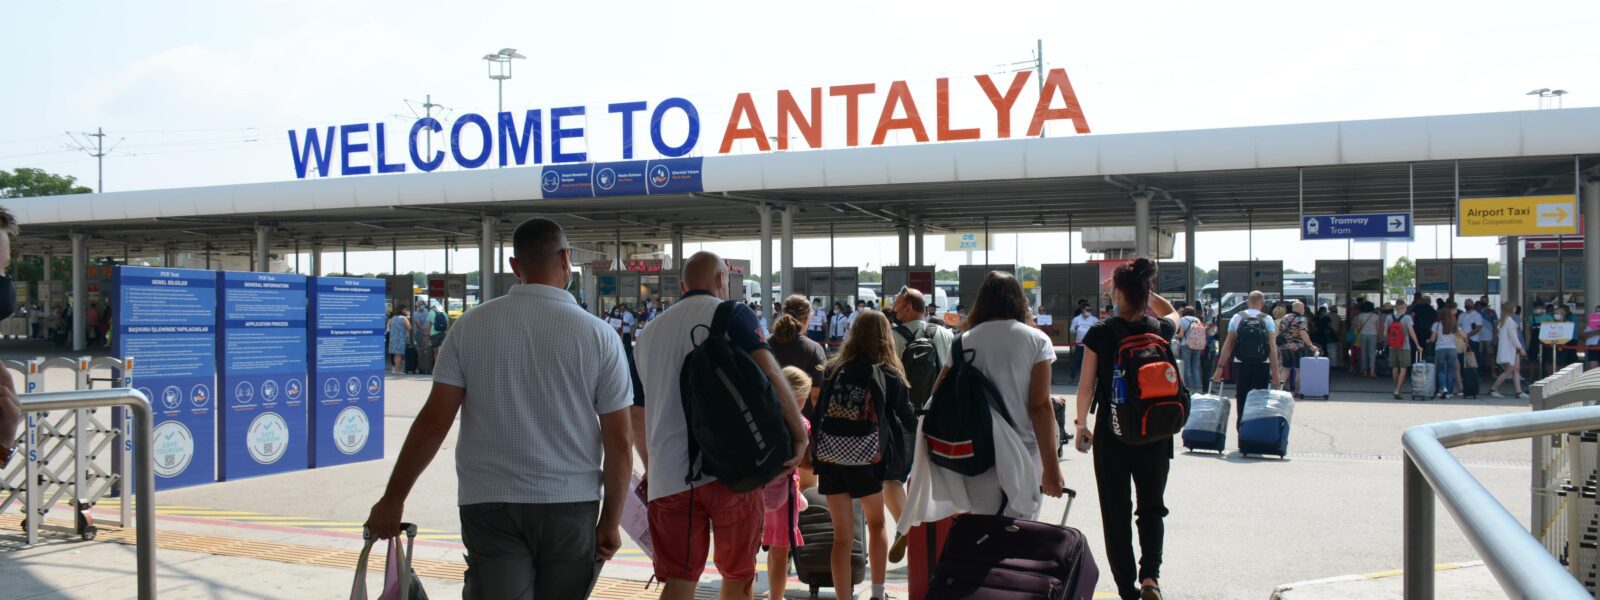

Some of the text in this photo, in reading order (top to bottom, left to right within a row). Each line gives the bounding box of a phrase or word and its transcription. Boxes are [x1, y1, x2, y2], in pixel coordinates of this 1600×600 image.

[288, 68, 1091, 179] WELCOME TO ANTALYA
[1467, 207, 1530, 218] Airport Taxi
[1330, 216, 1369, 226] Tramvay
[1482, 218, 1523, 226] Cooperative
[1330, 226, 1351, 234] Tram
